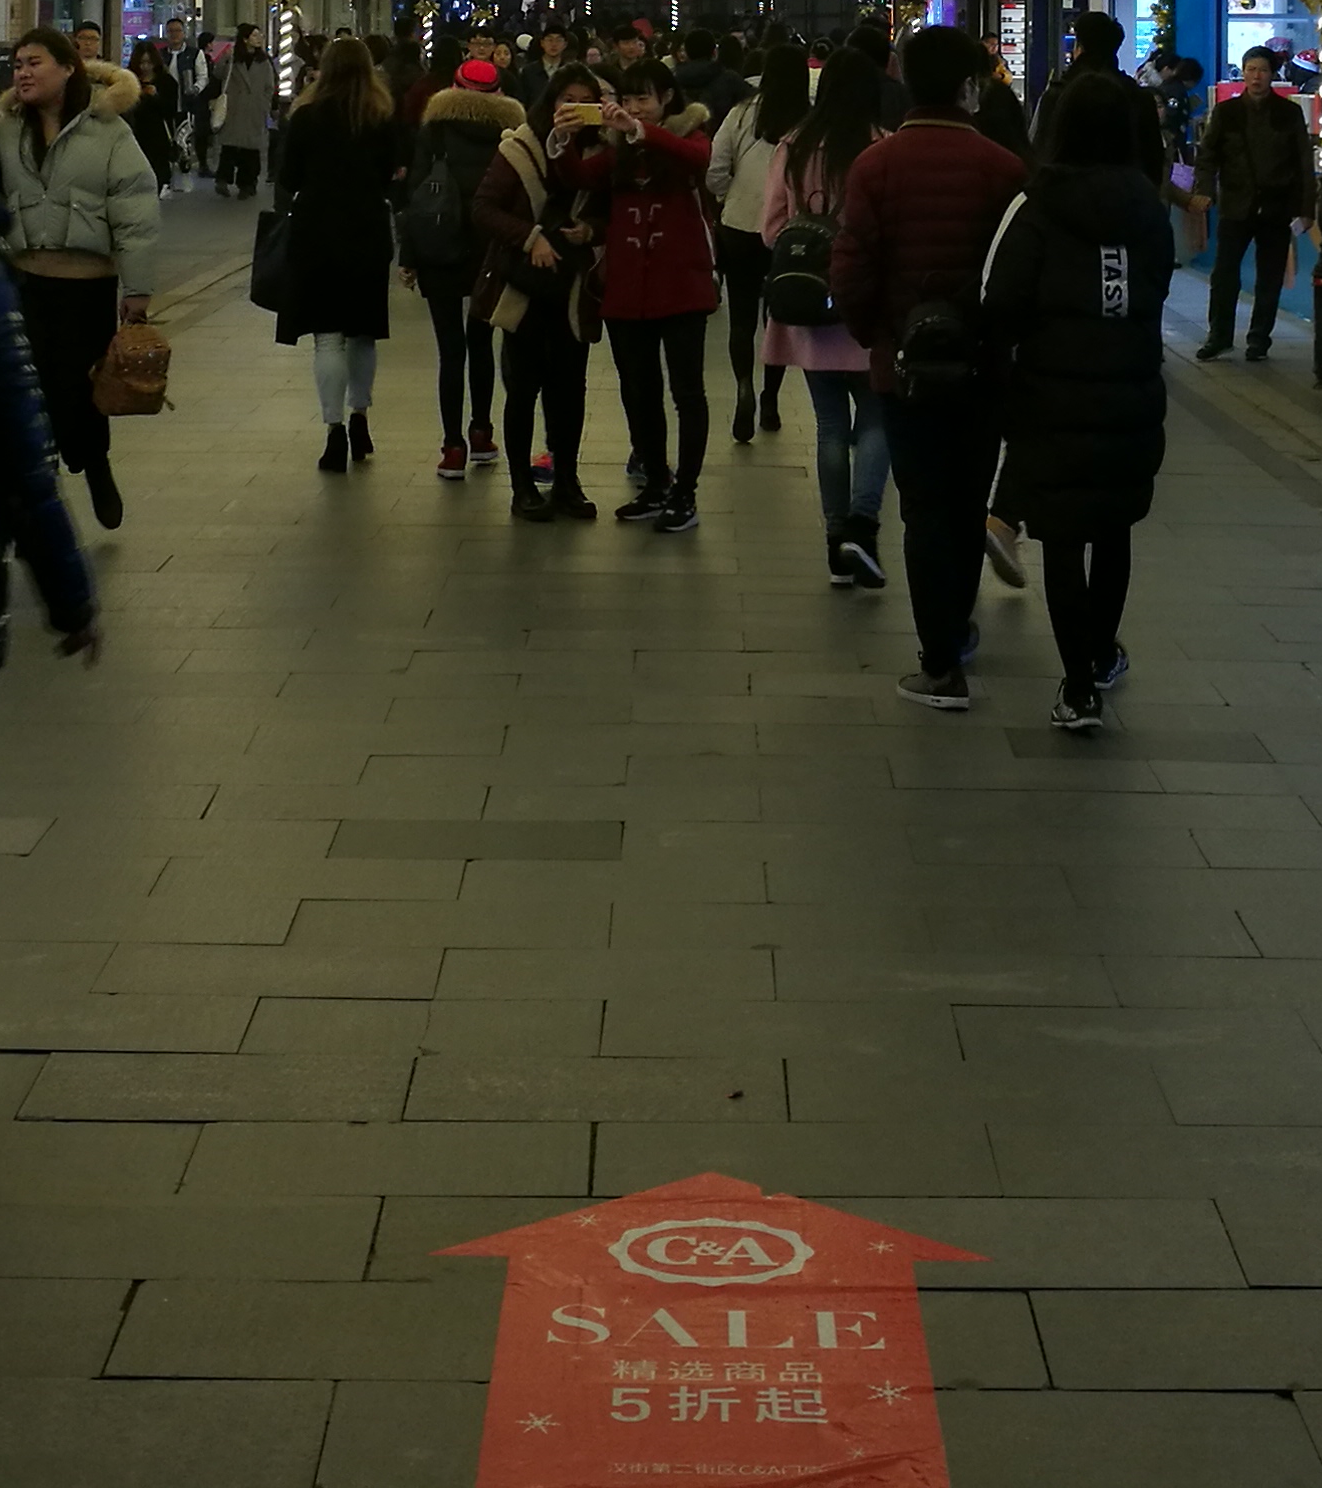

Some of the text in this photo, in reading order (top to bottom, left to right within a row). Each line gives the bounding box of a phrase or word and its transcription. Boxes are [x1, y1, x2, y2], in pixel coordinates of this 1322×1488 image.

[647, 1235, 779, 1266] C&A
[547, 1304, 886, 1349] SALE
[612, 1360, 822, 1383] 精选商品
[610, 1385, 829, 1423] 5折起
